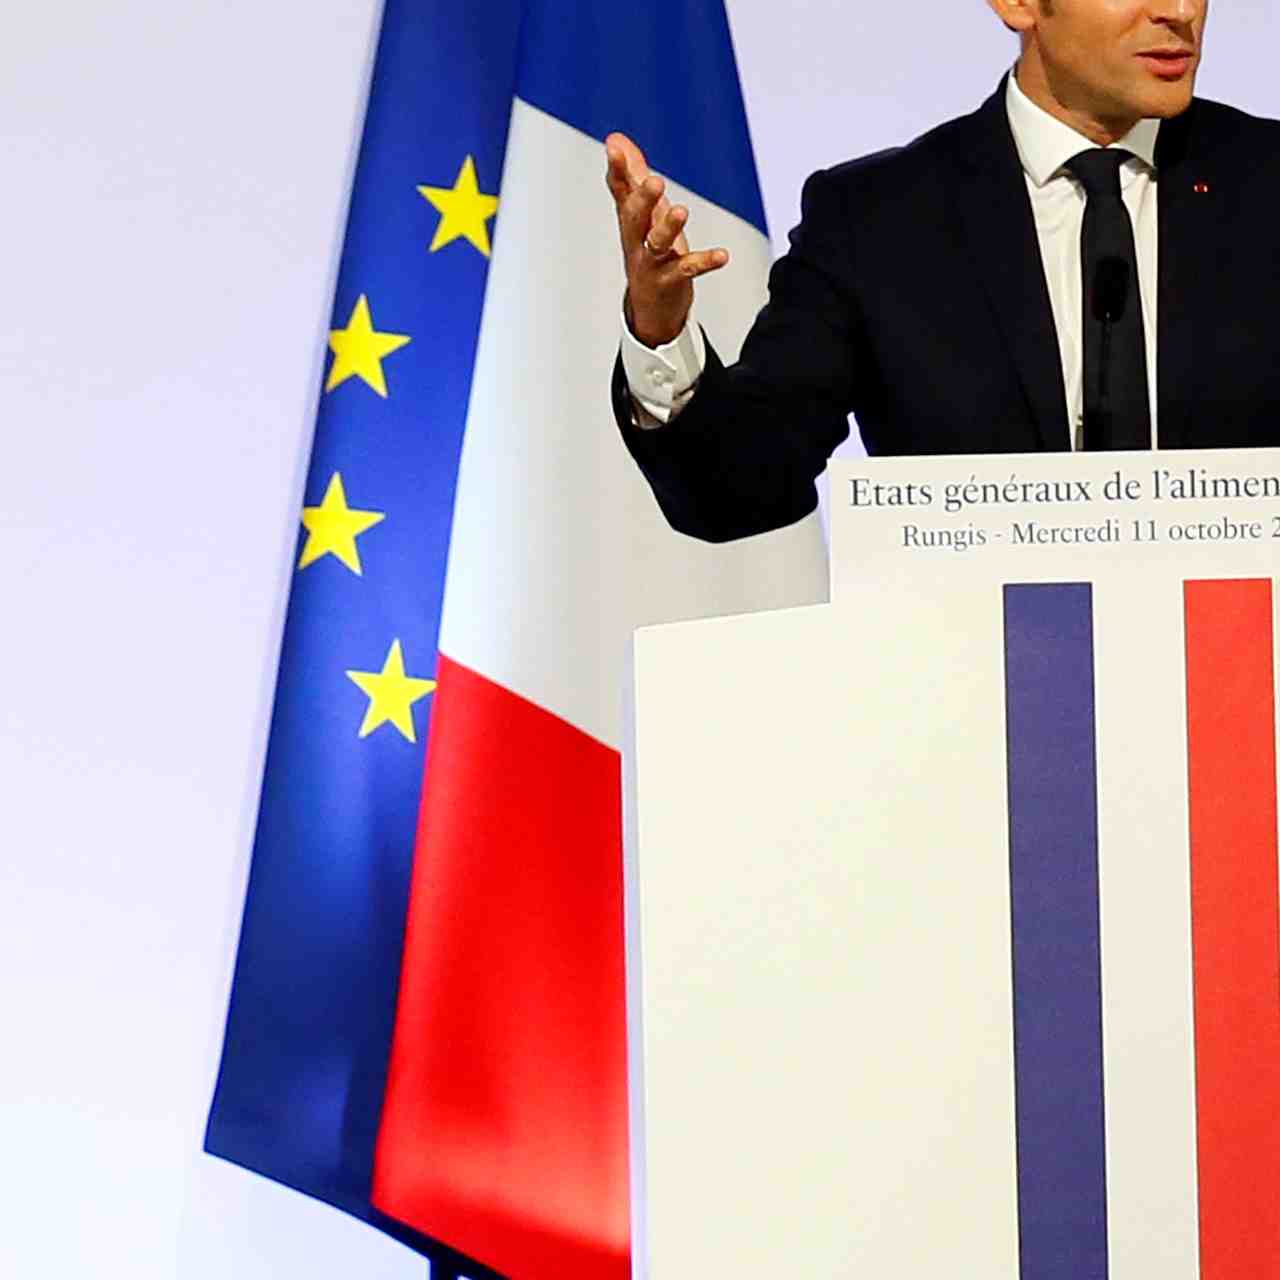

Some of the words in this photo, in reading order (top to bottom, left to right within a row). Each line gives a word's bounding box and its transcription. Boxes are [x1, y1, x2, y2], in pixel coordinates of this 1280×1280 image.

[849, 477, 933, 507] Etats
[944, 473, 1092, 513] généraux
[1103, 471, 1142, 500] de
[902, 523, 988, 552] Rungis
[1011, 519, 1121, 545] Mercredi
[1132, 519, 1159, 542] 11
[1168, 516, 1263, 541] octobre
